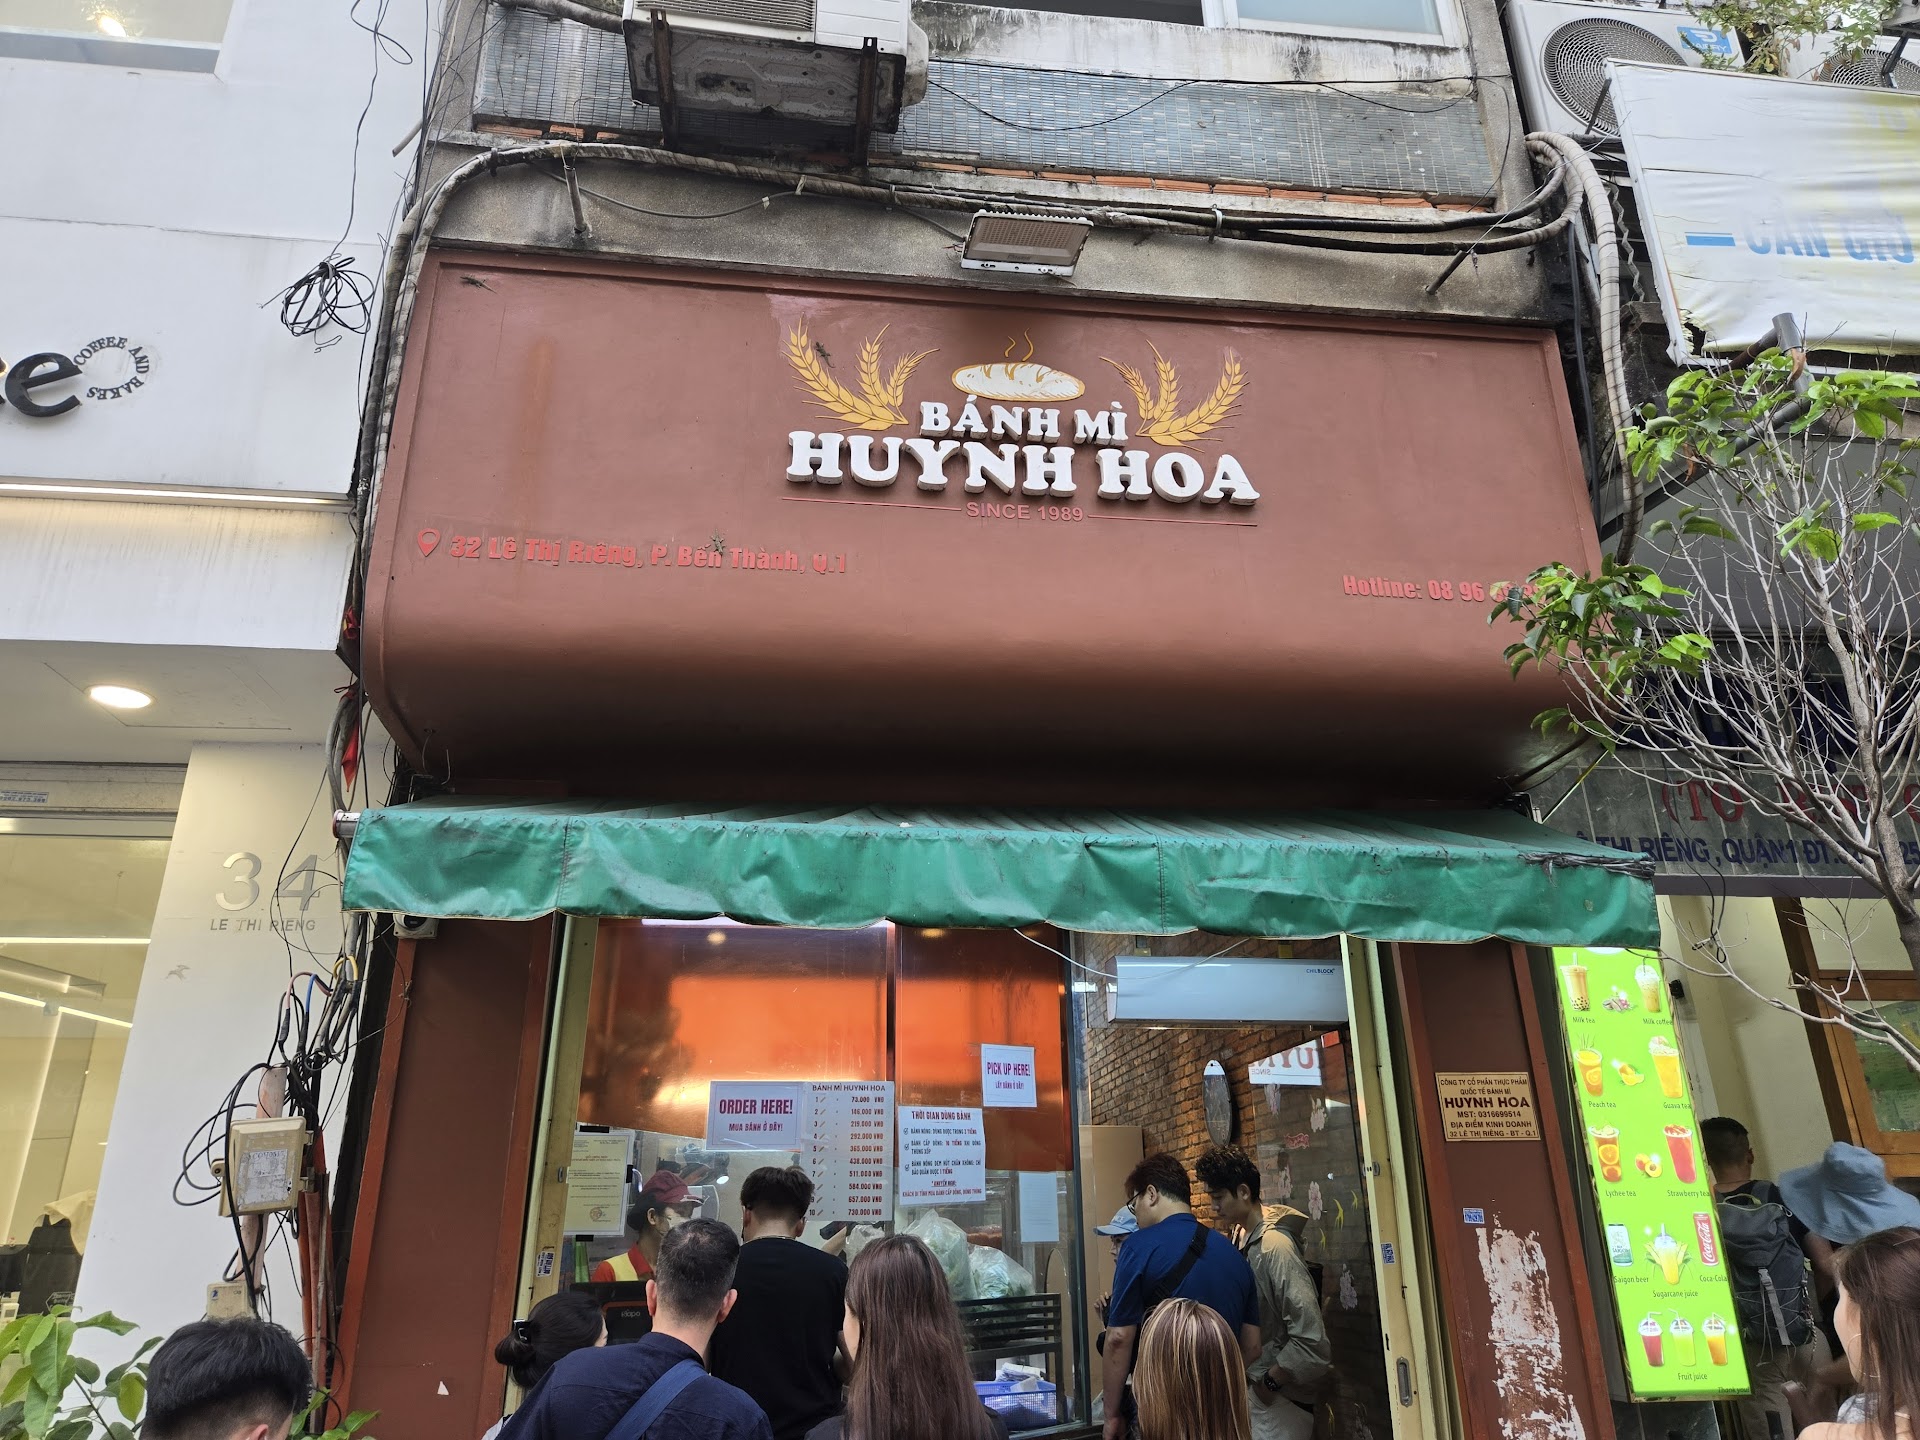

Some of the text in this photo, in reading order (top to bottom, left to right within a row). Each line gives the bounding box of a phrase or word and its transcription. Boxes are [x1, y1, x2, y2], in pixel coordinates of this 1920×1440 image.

[73, 336, 128, 366] COFFEE
[128, 346, 150, 374] AND
[86, 376, 144, 400] BAKES
[920, 394, 1128, 447] BÁNH MÌ
[785, 431, 1260, 506] HUYNH HOA
[966, 502, 1084, 522] SINCE 1989
[450, 534, 846, 574] 32 Lê Thị Riêng, P. Bến Thành, Q.1
[1342, 575, 1422, 599] Hotline:
[1428, 579, 1454, 600] 08
[1459, 582, 1484, 602] 96
[216, 852, 320, 911] 34
[210, 919, 316, 932] LE THI RIENG
[987, 1062, 1030, 1076] PICK UP HERE!
[812, 1083, 832, 1091] BÁNH
[720, 1099, 793, 1114] ORDER HERE!
[1444, 1097, 1530, 1108] HUYNH HOA
[745, 1123, 761, 1131] BÁNH
[1465, 1118, 1483, 1127] ĐIỂM
[1668, 1190, 1699, 1198] Strawberry
[1614, 1276, 1634, 1284] Saigon
[1653, 1290, 1684, 1299] Sugarcane
[1693, 1373, 1708, 1381] juice
